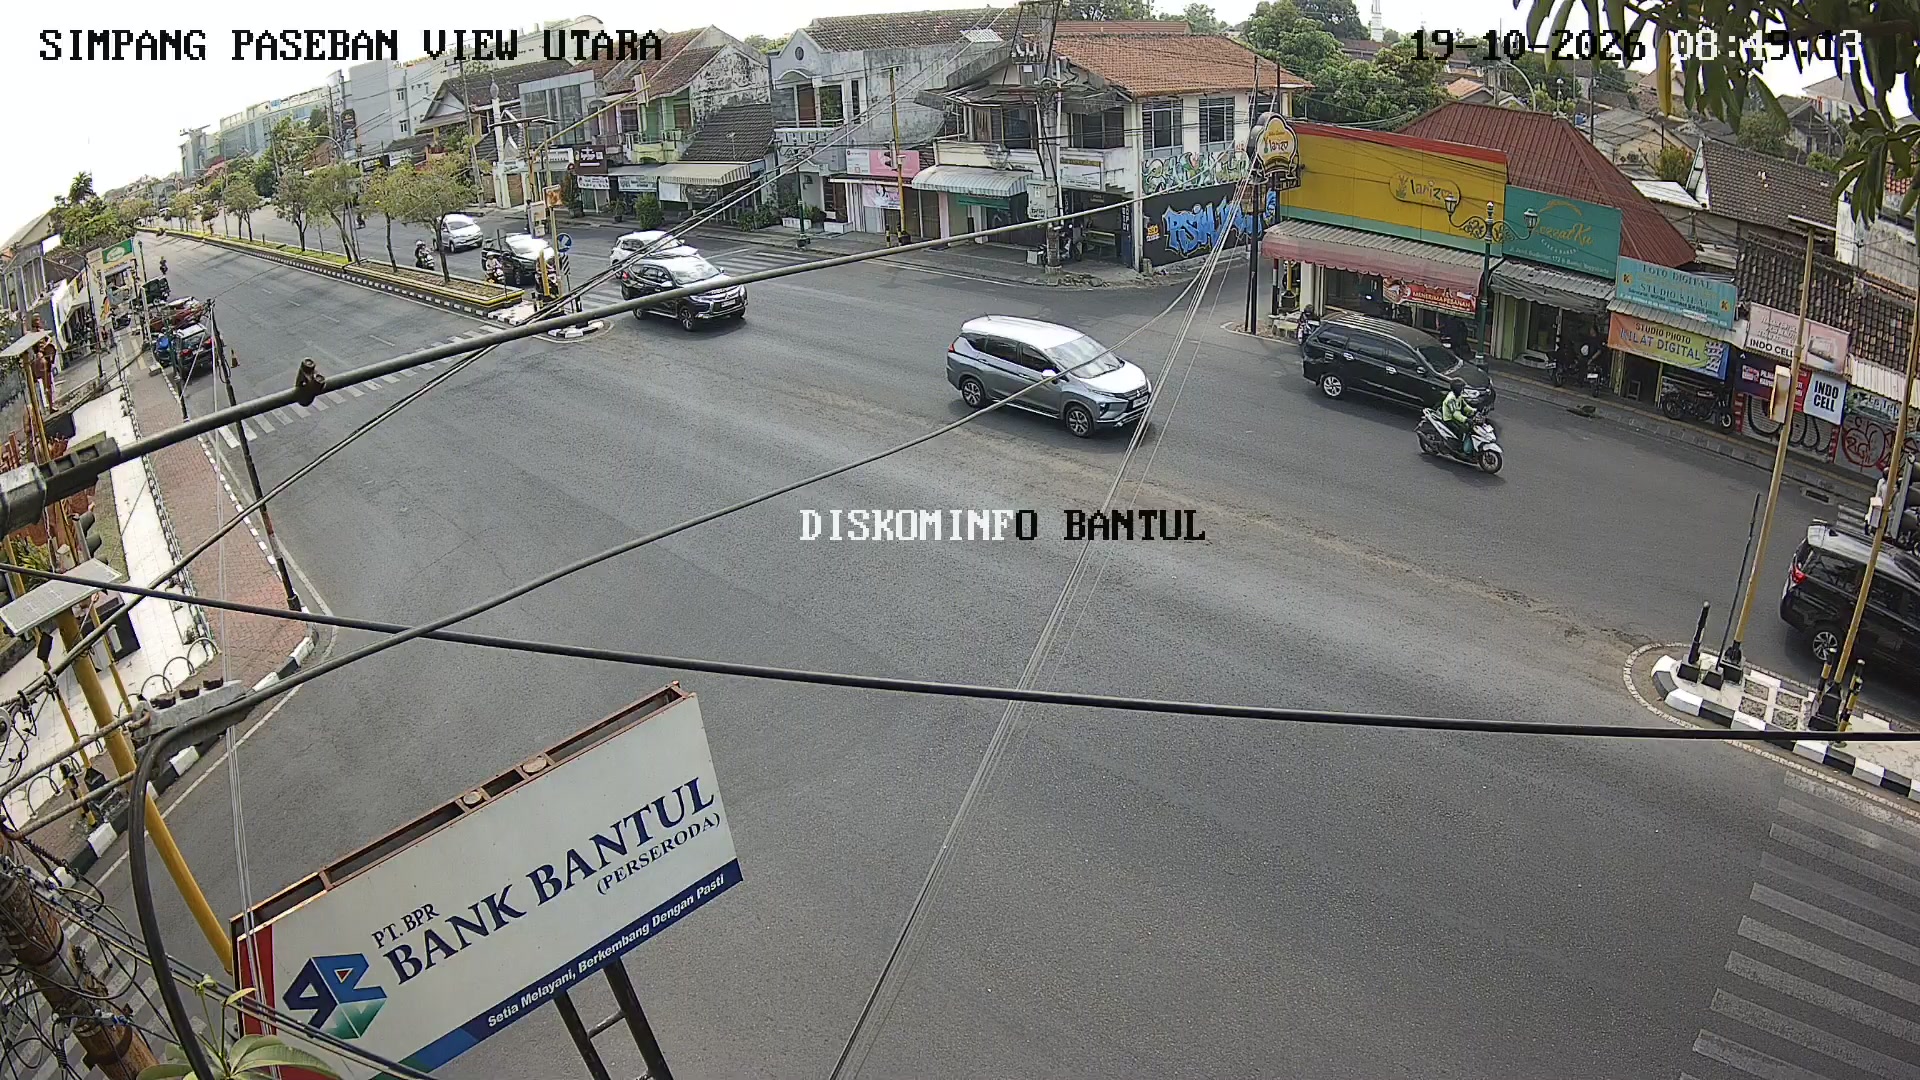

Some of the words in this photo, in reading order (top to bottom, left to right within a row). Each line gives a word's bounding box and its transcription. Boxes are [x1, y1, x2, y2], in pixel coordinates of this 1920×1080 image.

[1642, 264, 1668, 278] FOTO
[1671, 271, 1713, 290] DIGITAL
[1640, 283, 1676, 299] STUDIO
[1620, 328, 1654, 347] KILAT
[1657, 340, 1701, 360] DIGITAL
[1635, 323, 1664, 337] STUDIO
[1665, 331, 1691, 345] PHOTO
[1750, 339, 1773, 352] INDO
[1814, 380, 1839, 399] INDO
[1813, 394, 1835, 412] CELL
[597, 812, 722, 896] (PERSERODA)
[382, 885, 528, 985] BANK
[525, 776, 715, 907] BANTUL
[487, 1003, 519, 1028] Setia
[520, 970, 577, 1009] Melayani,
[577, 922, 650, 974] Berkembang
[651, 895, 694, 929] Dengan
[696, 874, 724, 900] Pasti
